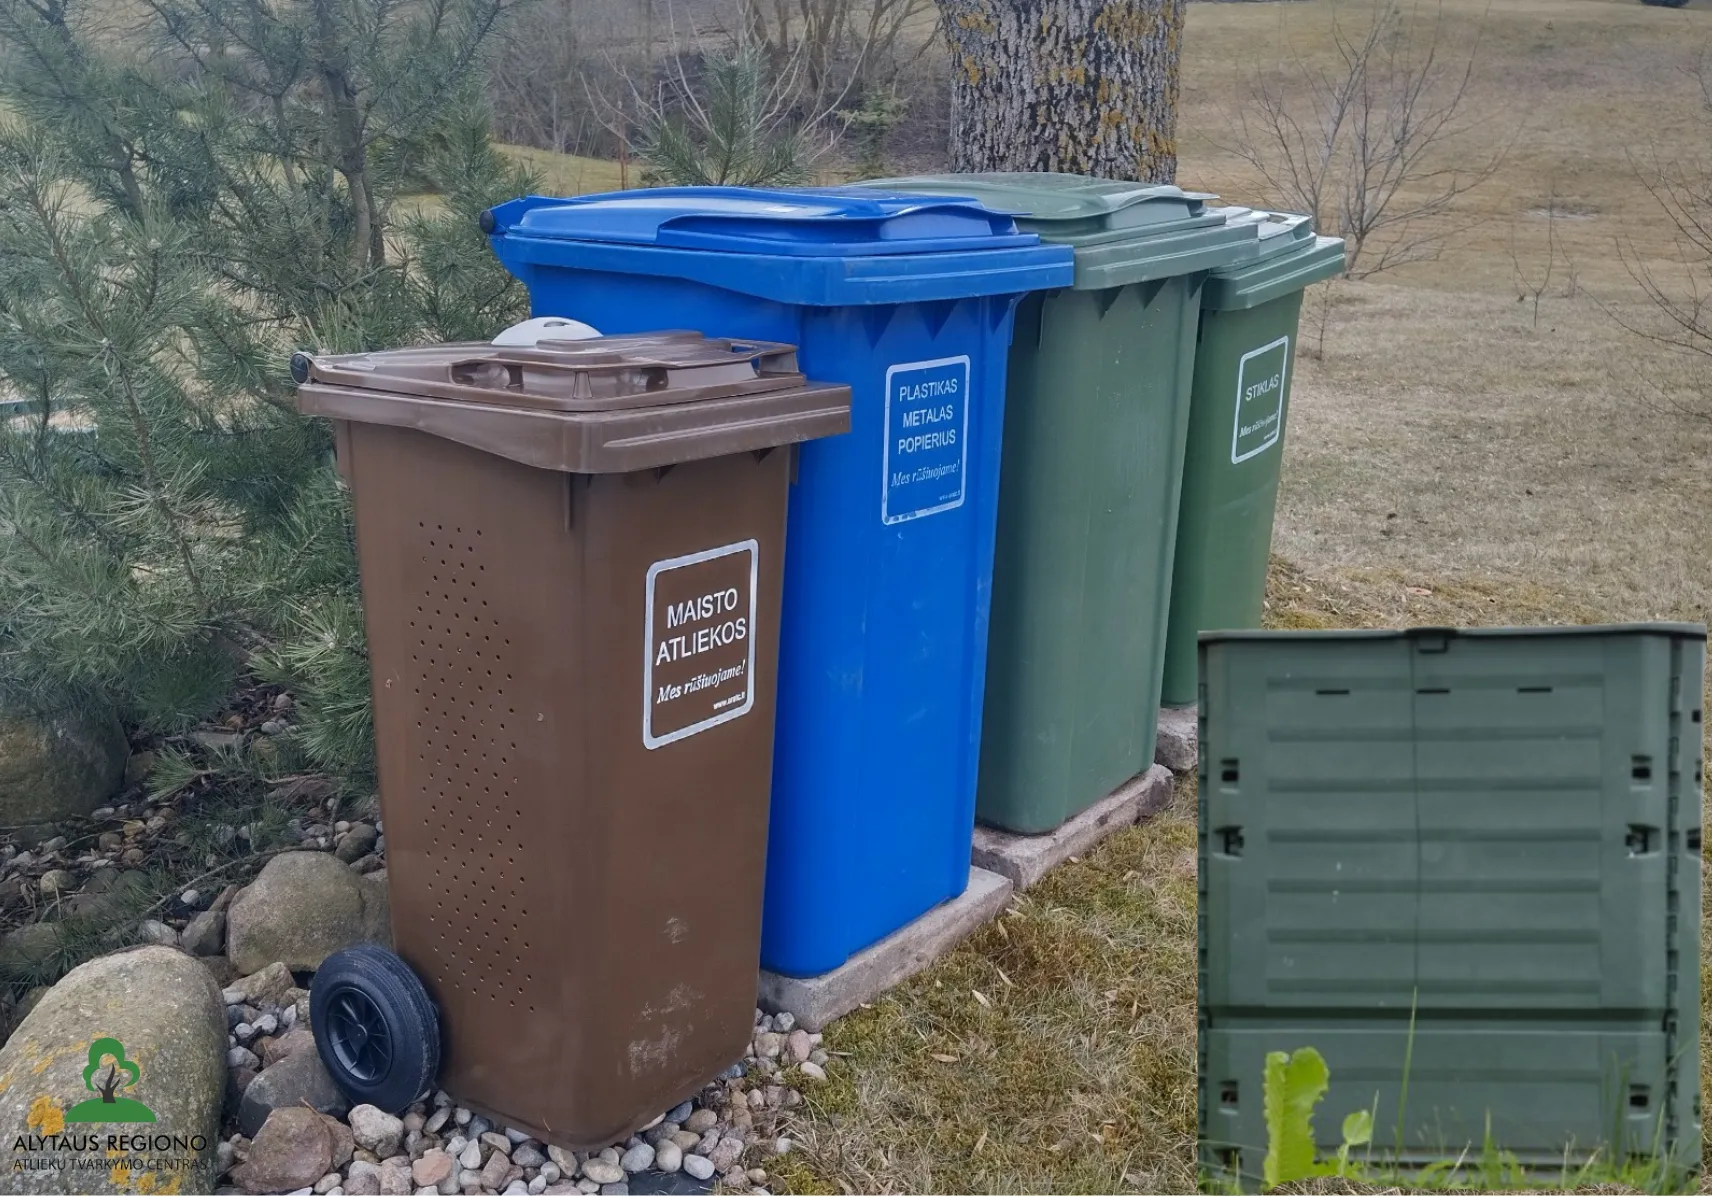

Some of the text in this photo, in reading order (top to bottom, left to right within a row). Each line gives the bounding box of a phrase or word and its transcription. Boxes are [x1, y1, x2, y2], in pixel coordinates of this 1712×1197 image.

[899, 378, 958, 402] PLASTIKAS
[1245, 373, 1280, 402] STIKLAS
[902, 404, 954, 428] METALAS
[898, 429, 956, 455] POPIERIUS
[891, 471, 910, 487] Mes
[667, 587, 738, 629] MAISTO
[655, 617, 747, 666] ATLIEKOS
[656, 658, 746, 704] Mes rūšiuojame!
